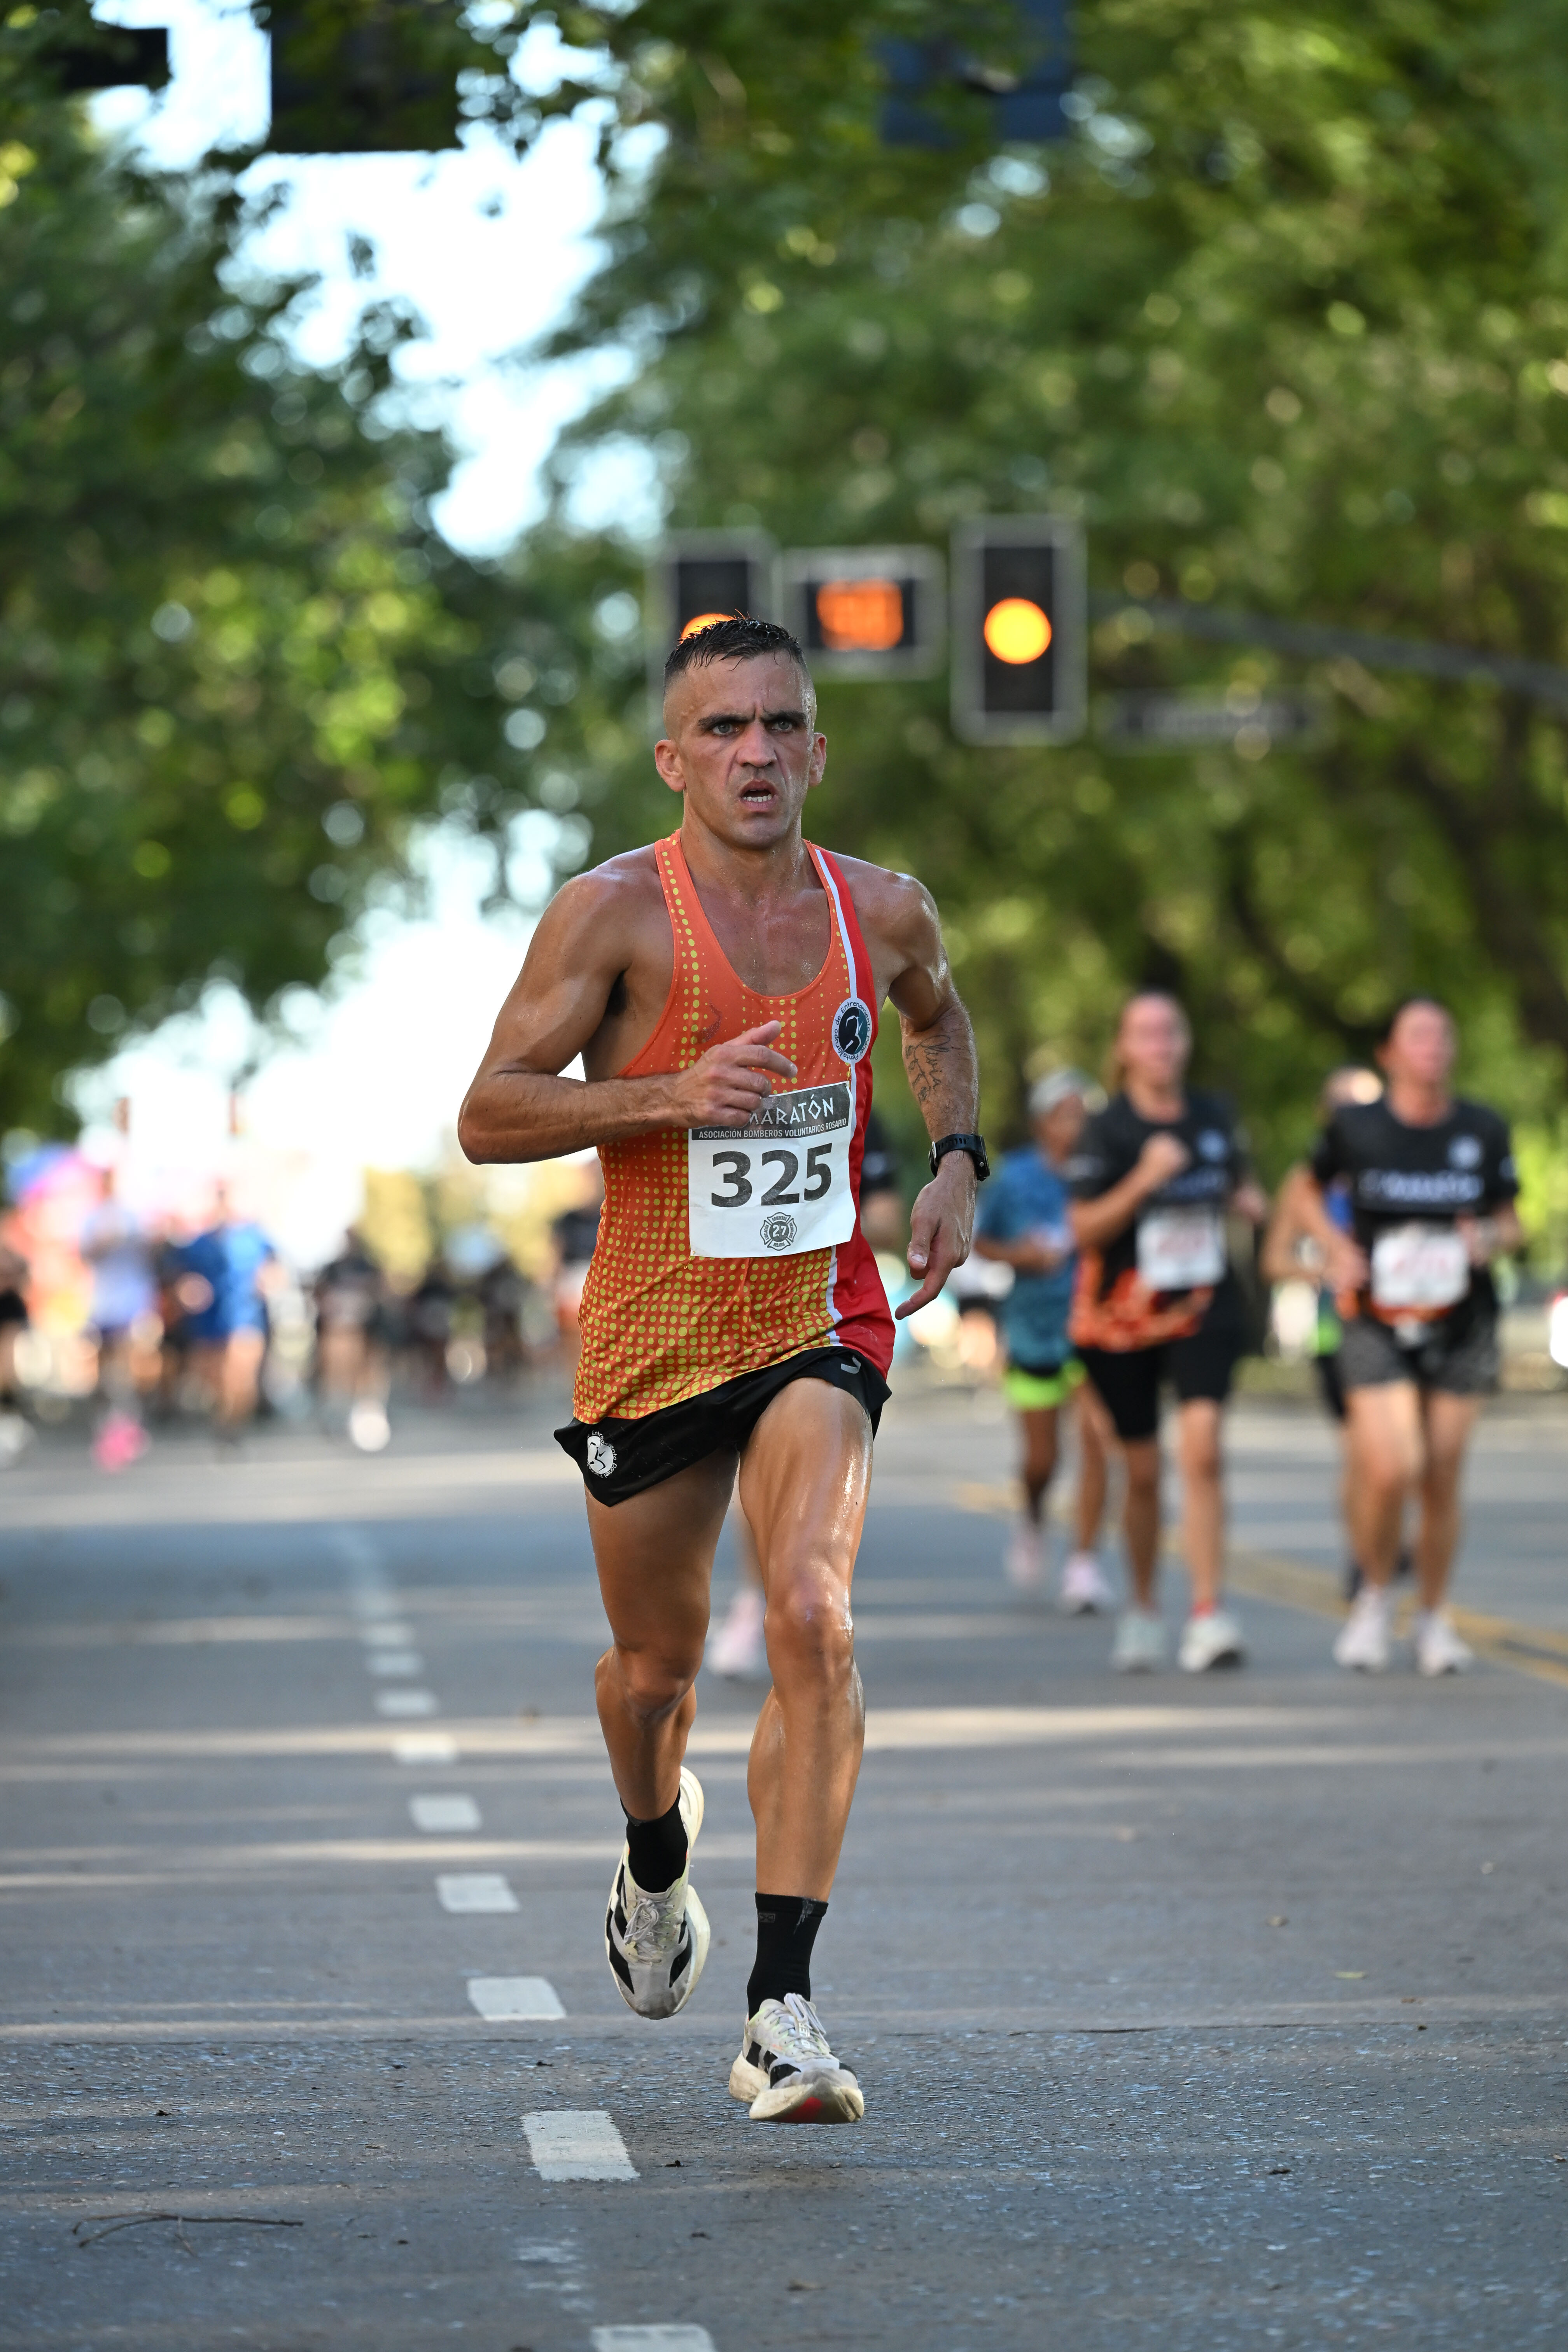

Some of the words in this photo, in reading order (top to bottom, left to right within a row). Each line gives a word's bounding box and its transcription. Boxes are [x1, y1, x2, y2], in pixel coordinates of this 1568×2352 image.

[835, 1015, 841, 1025] de
[860, 1036, 870, 1056] Daniel
[699, 1129, 742, 1139] ASOCIACIÓN
[785, 1124, 824, 1137] VOLUNTARIOS
[825, 1118, 846, 1130] ROSARIO
[711, 1143, 833, 1208] 325
[772, 1224, 787, 1237] 27
